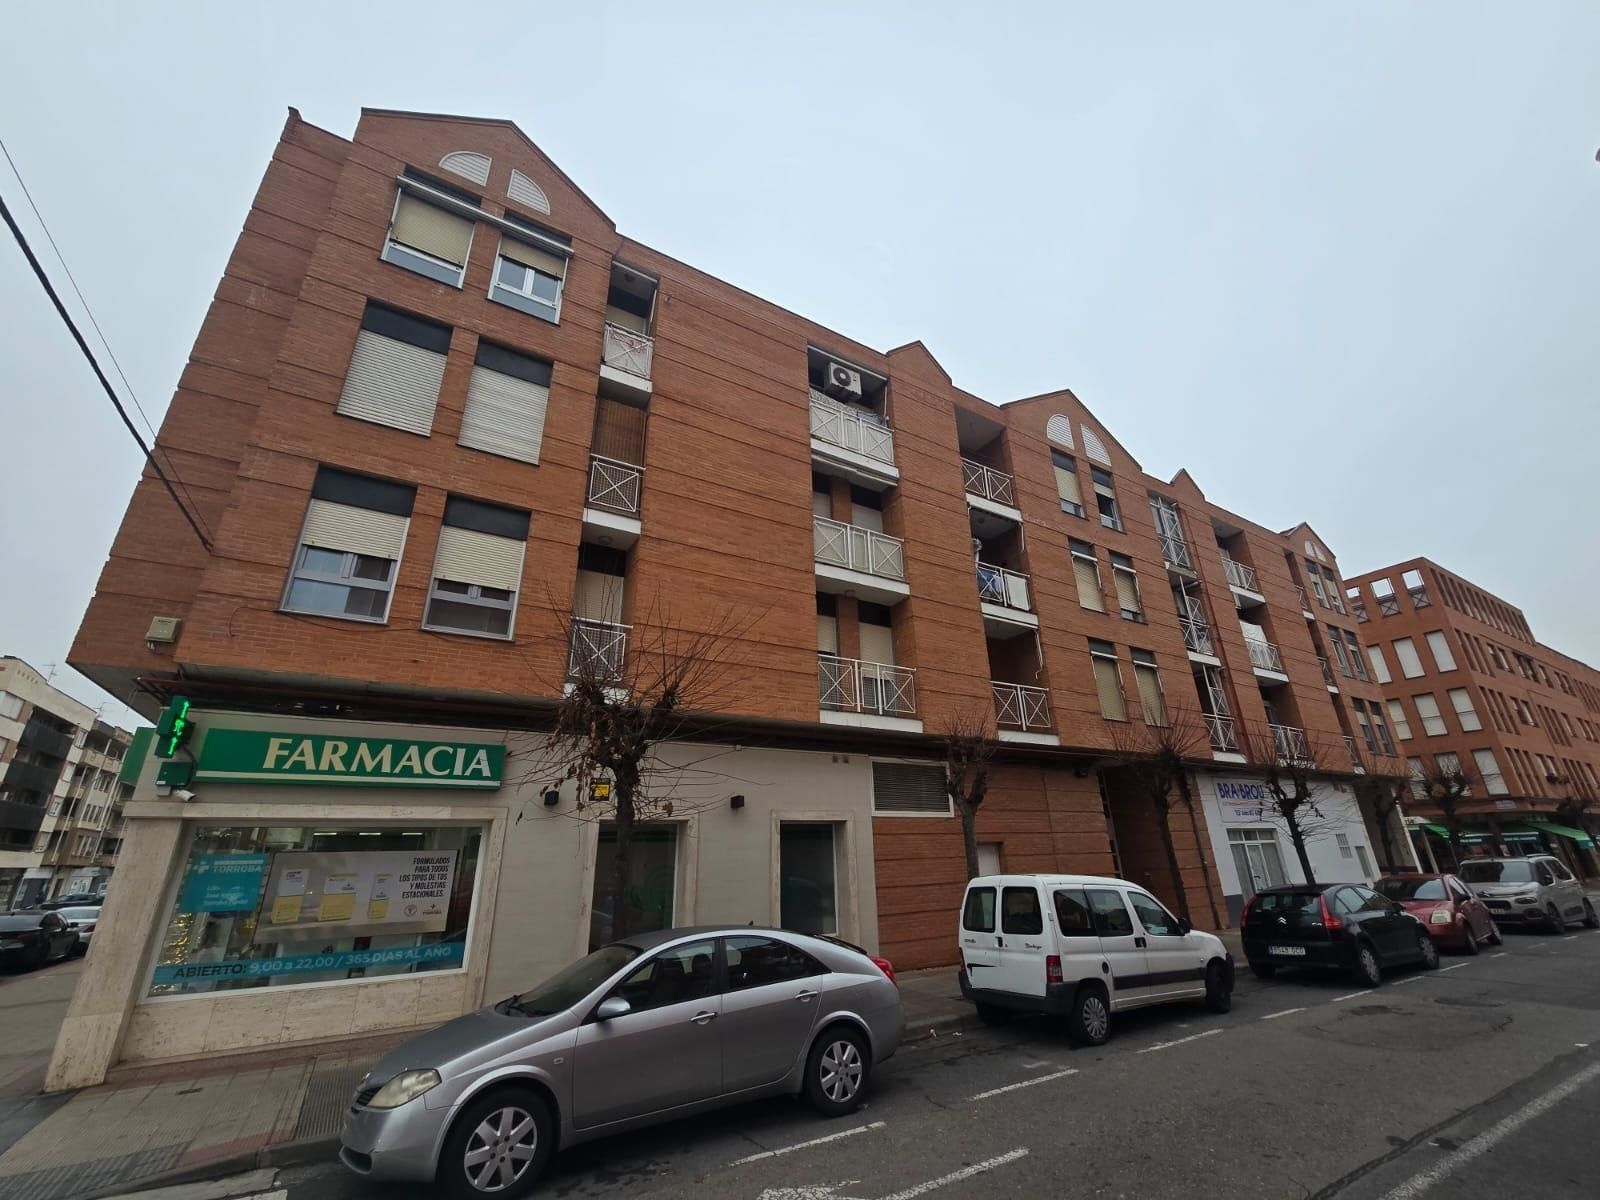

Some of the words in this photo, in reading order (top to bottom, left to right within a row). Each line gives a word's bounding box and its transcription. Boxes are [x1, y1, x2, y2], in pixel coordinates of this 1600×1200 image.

[262, 737, 491, 777] FARMACIA
[413, 856, 450, 865] FORMULADOS
[213, 865, 262, 873] TORROBA
[415, 865, 430, 873] PARA
[431, 865, 449, 873] TODOS
[399, 874, 410, 882] LOS
[411, 873, 428, 882] TIPOS
[428, 873, 436, 881] DE
[437, 873, 448, 881] TOS
[410, 882, 416, 890] Y
[416, 881, 447, 890] MOLESTIAS
[173, 963, 247, 979] ABIERTO:
[249, 960, 283, 975] 9,00
[295, 957, 334, 971] 22,00
[334, 955, 343, 968] /
[344, 953, 370, 965] 365
[404, 948, 421, 960] AL
